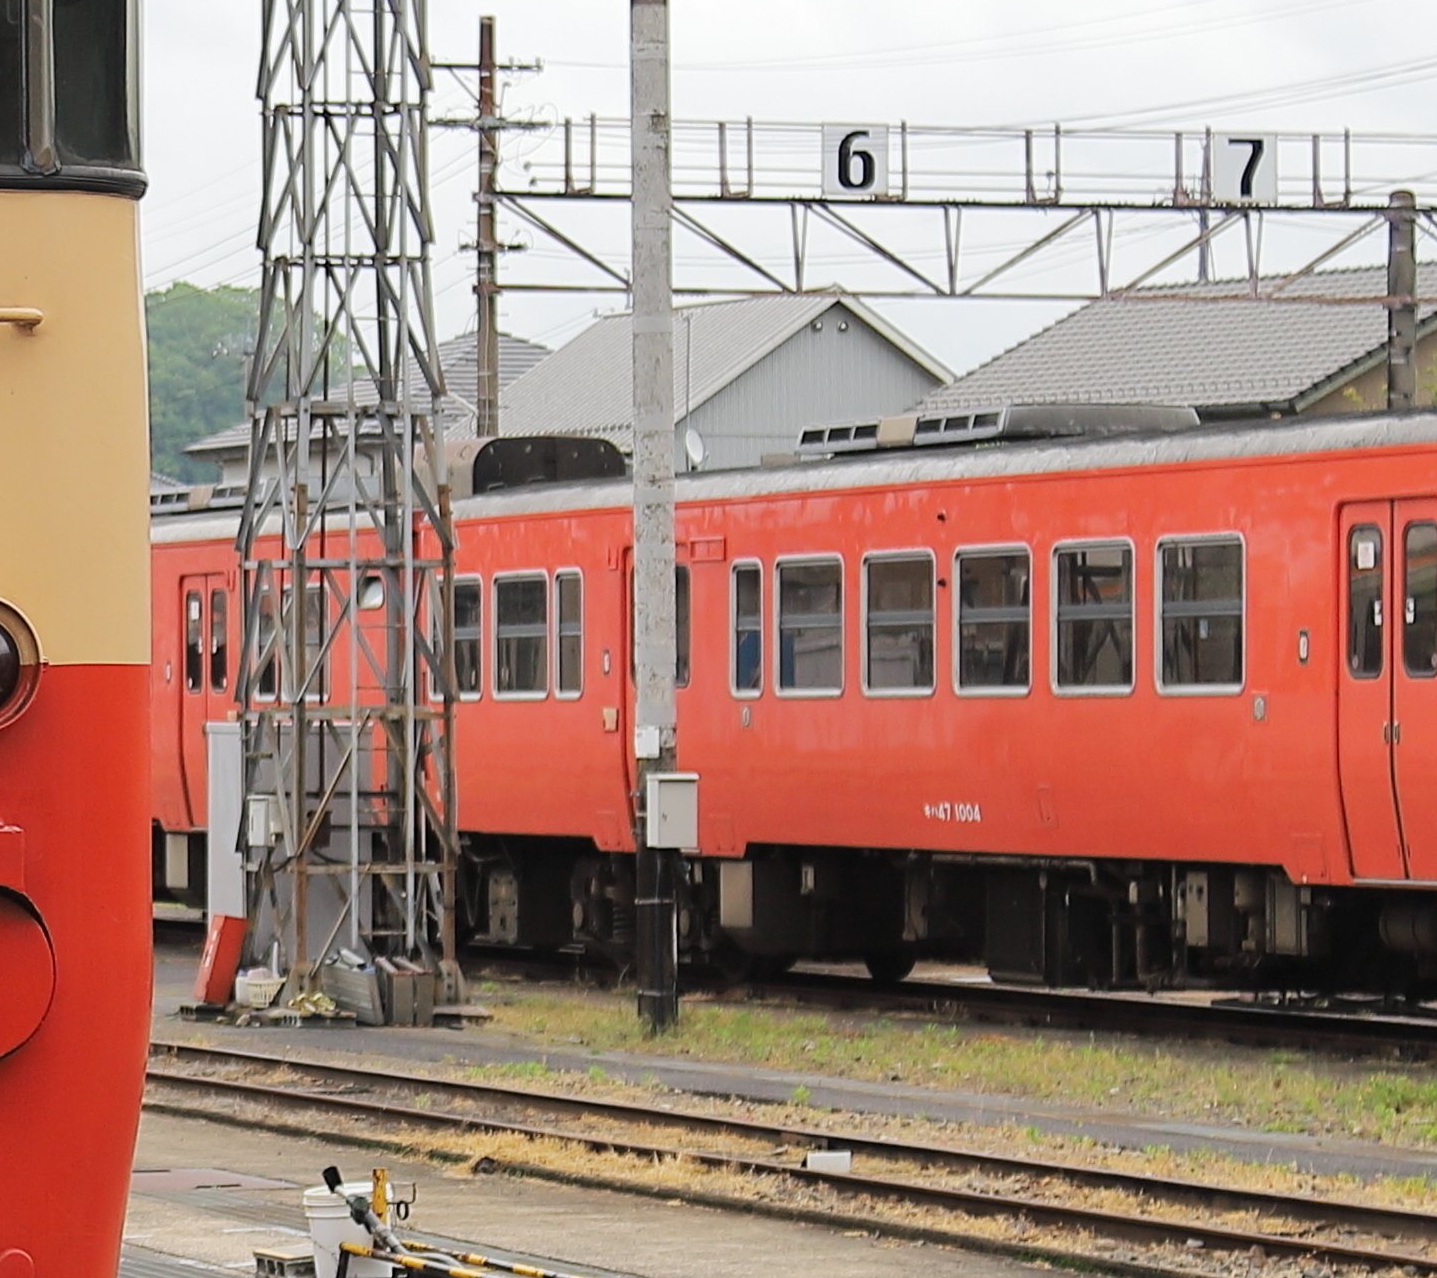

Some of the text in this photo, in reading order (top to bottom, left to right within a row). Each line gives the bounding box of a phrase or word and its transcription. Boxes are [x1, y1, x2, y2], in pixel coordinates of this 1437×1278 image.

[838, 130, 876, 190] 6
[1228, 138, 1264, 197] 7
[955, 803, 981, 823] 1004
